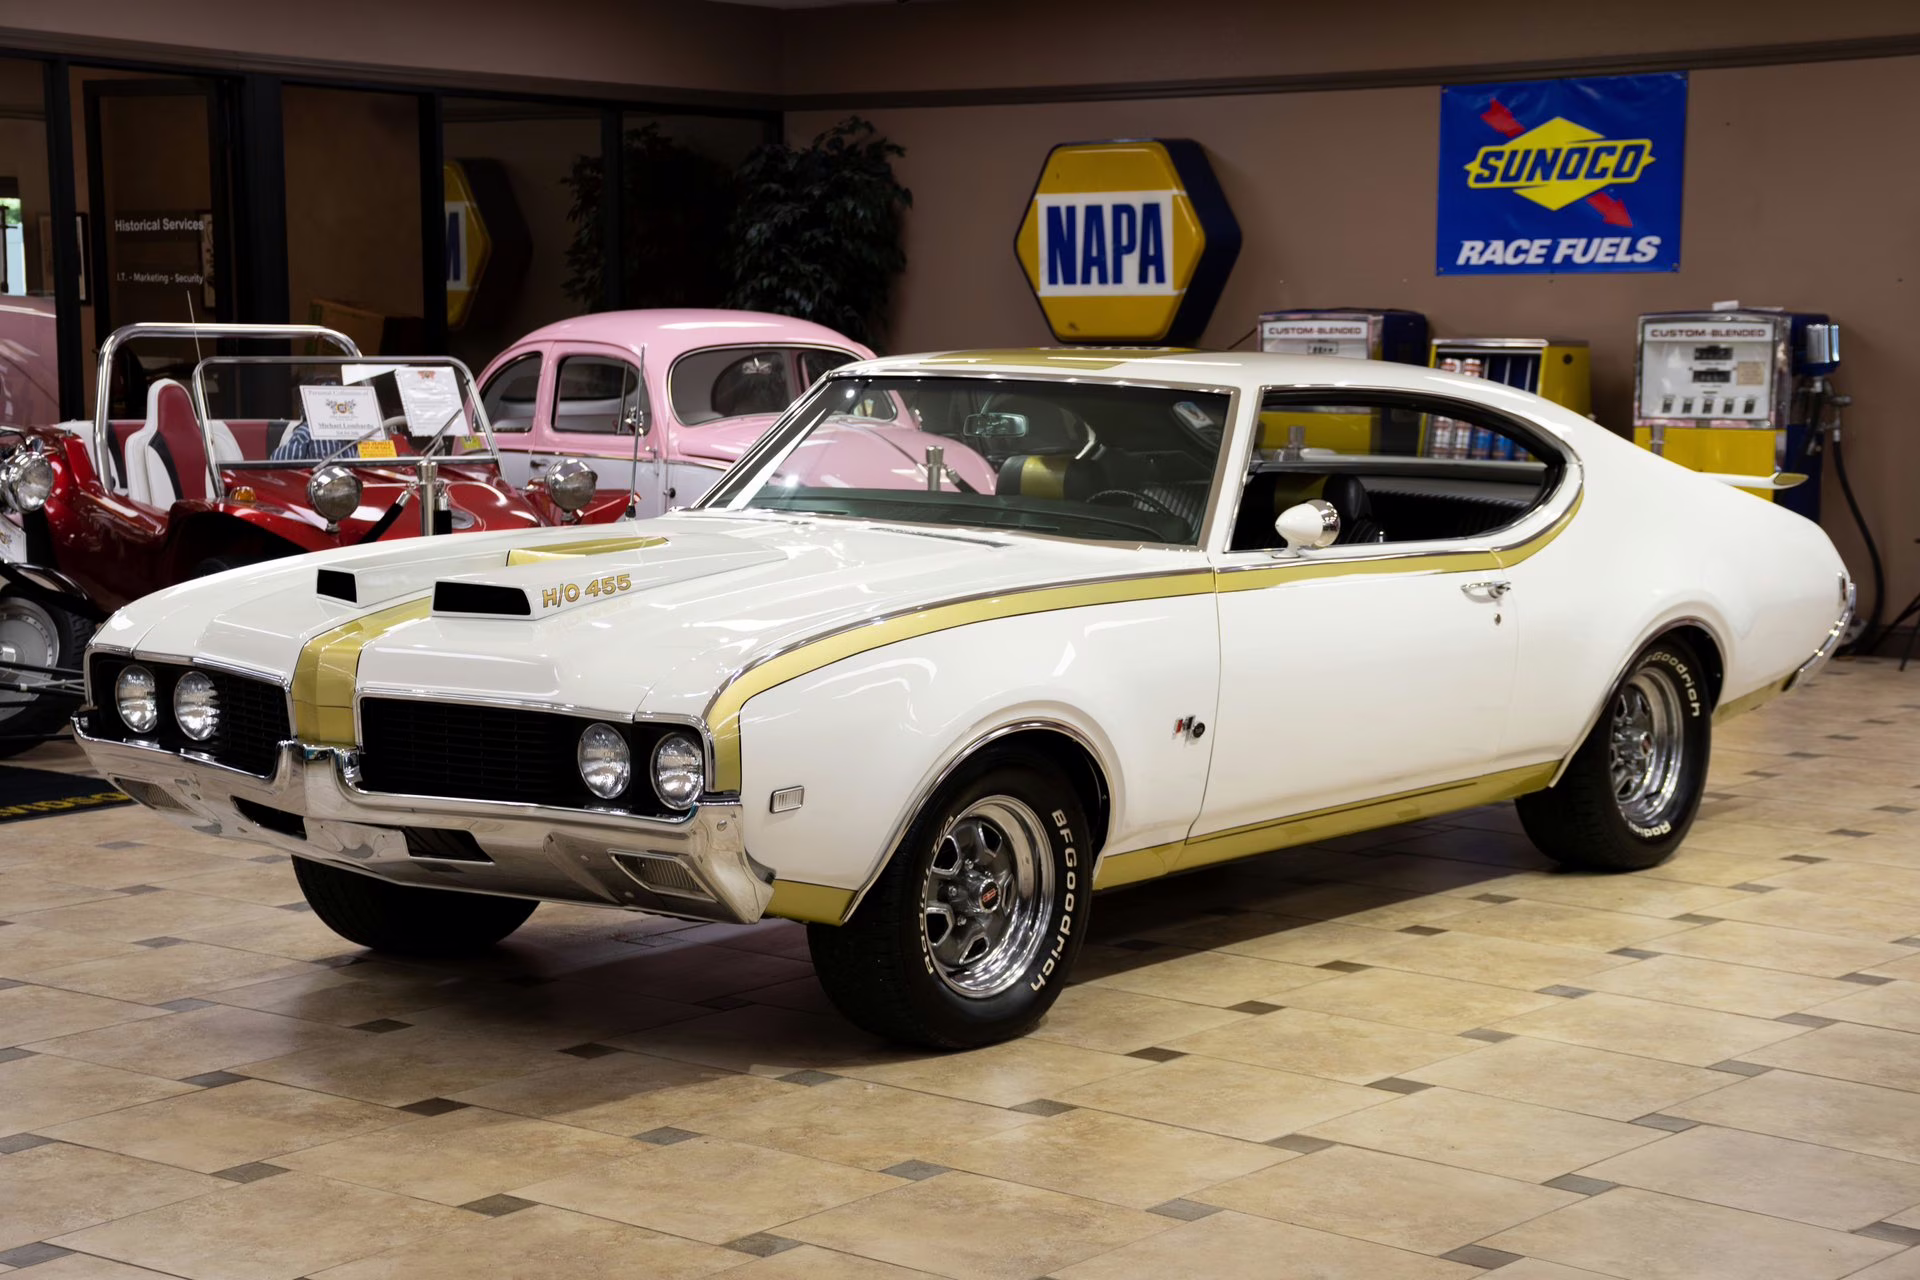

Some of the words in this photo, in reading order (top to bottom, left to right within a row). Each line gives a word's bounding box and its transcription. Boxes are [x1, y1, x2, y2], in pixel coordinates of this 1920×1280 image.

[1472, 143, 1648, 184] SUNOCO
[115, 218, 161, 232] Historical
[162, 217, 205, 231] Services
[1046, 202, 1166, 285] NAPA
[1456, 238, 1553, 266] RACE
[1552, 235, 1663, 264] FUELS
[133, 272, 169, 285] Marketing
[174, 273, 204, 285] Security
[541, 583, 581, 608] H/O
[584, 573, 632, 598] 455
[1030, 809, 1078, 992] BFGoodrich
